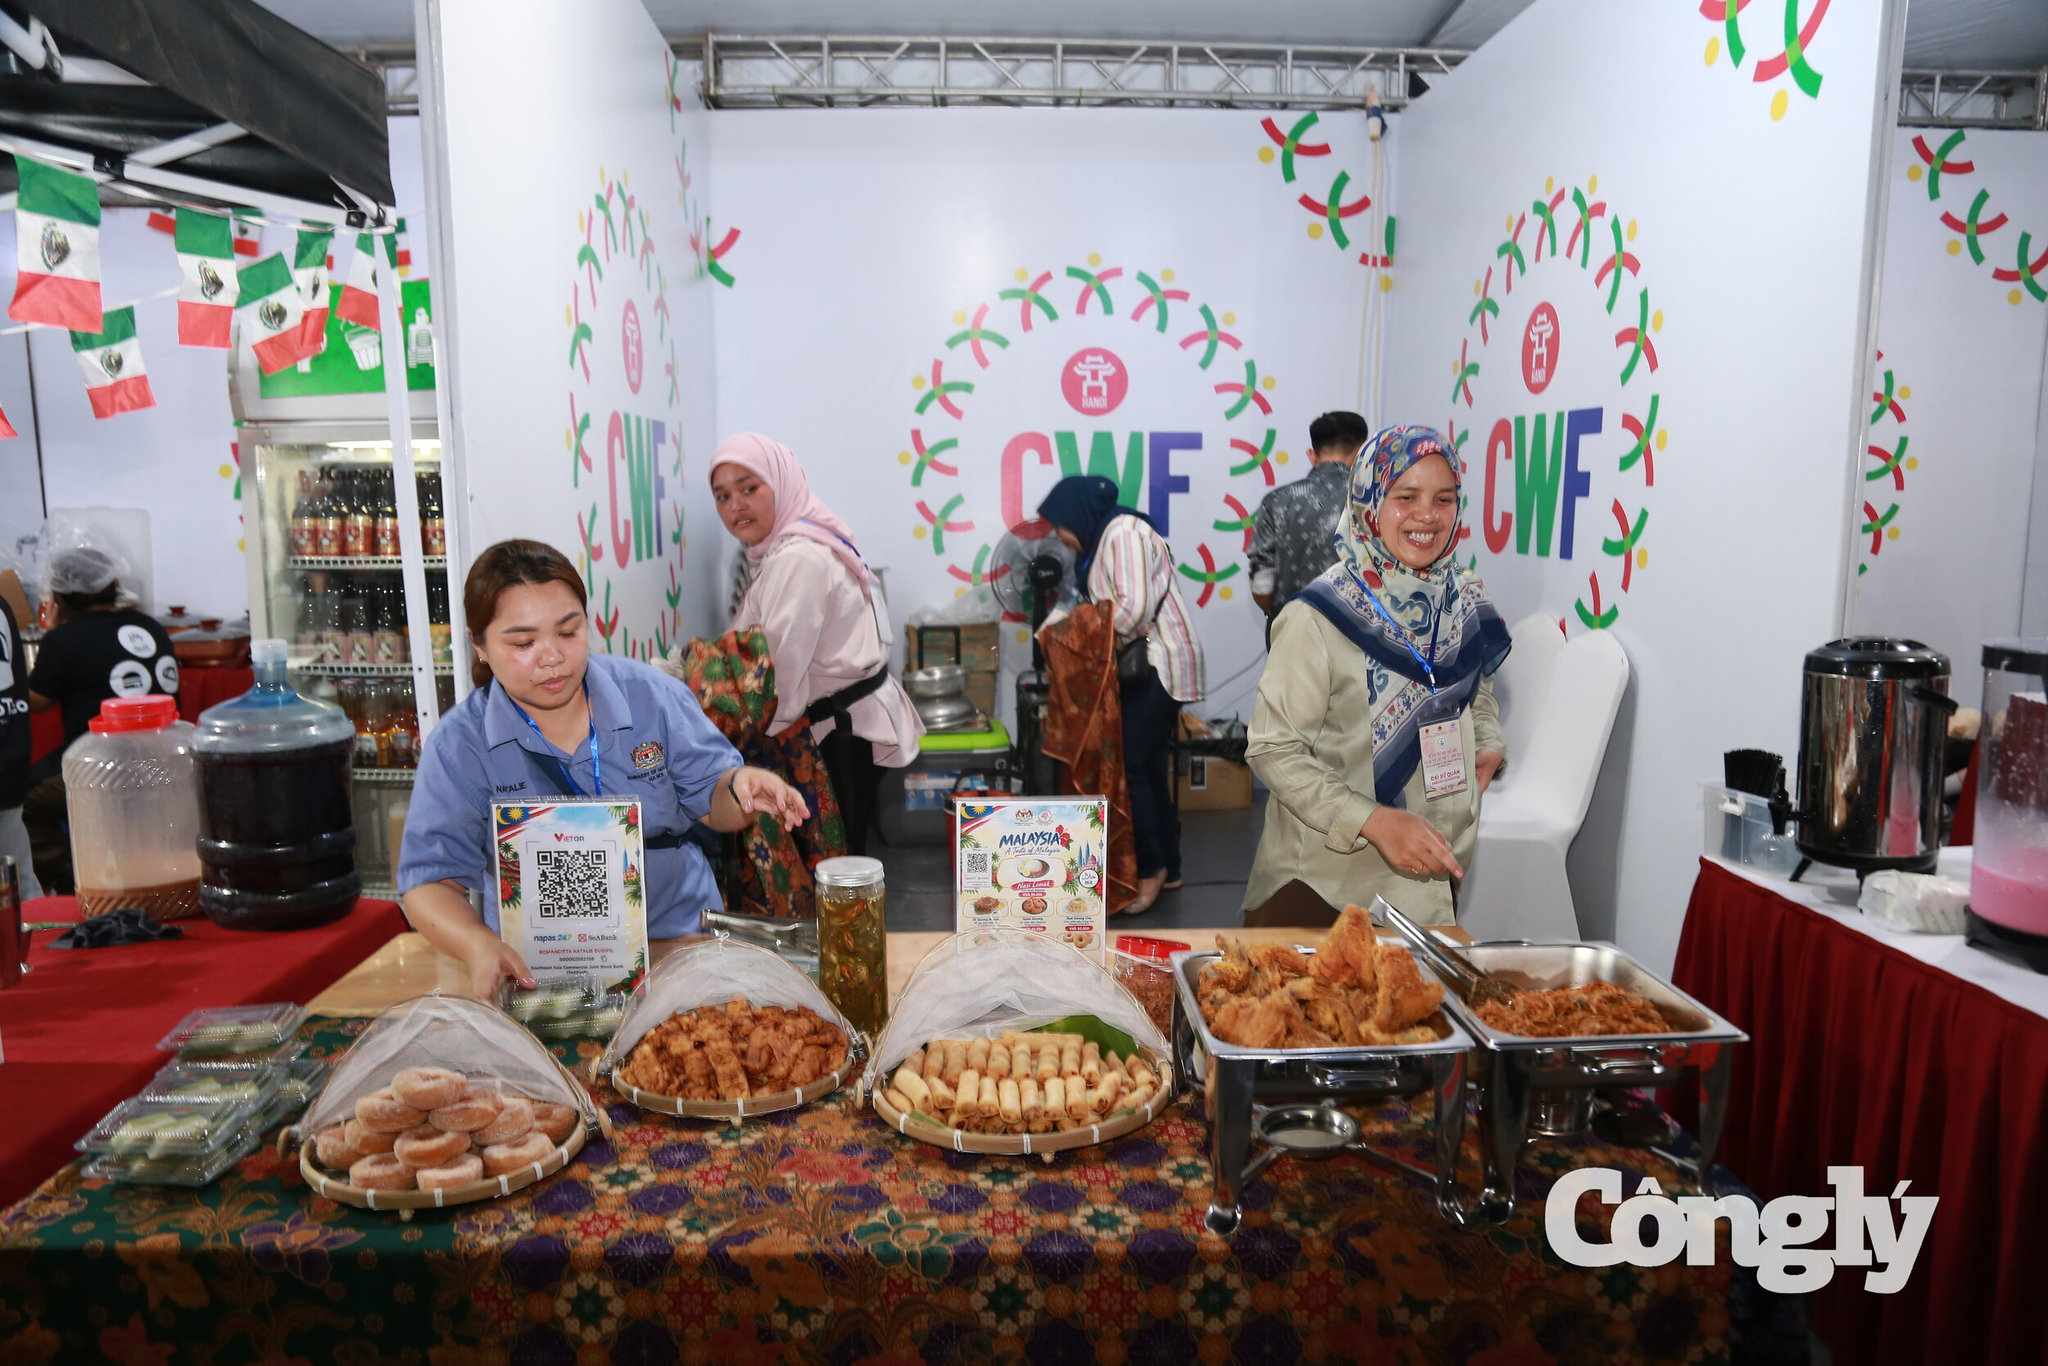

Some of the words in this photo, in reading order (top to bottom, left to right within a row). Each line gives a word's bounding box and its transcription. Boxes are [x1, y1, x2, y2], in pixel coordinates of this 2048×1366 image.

[1082, 397, 1108, 408] HANOI
[1483, 406, 1604, 560] CWF
[606, 410, 667, 570] CWF
[627, 772, 650, 781] EMBASSY
[496, 781, 527, 793] NATALIE
[554, 833, 585, 842] VIETQR
[999, 831, 1060, 848] MALAYSIA
[1013, 846, 1027, 854] Taste
[1035, 846, 1060, 856] Malaysia
[1017, 882, 1031, 890] Nasi
[1032, 880, 1050, 888] Lemak
[534, 935, 556, 943] napas
[557, 934, 572, 942] 247
